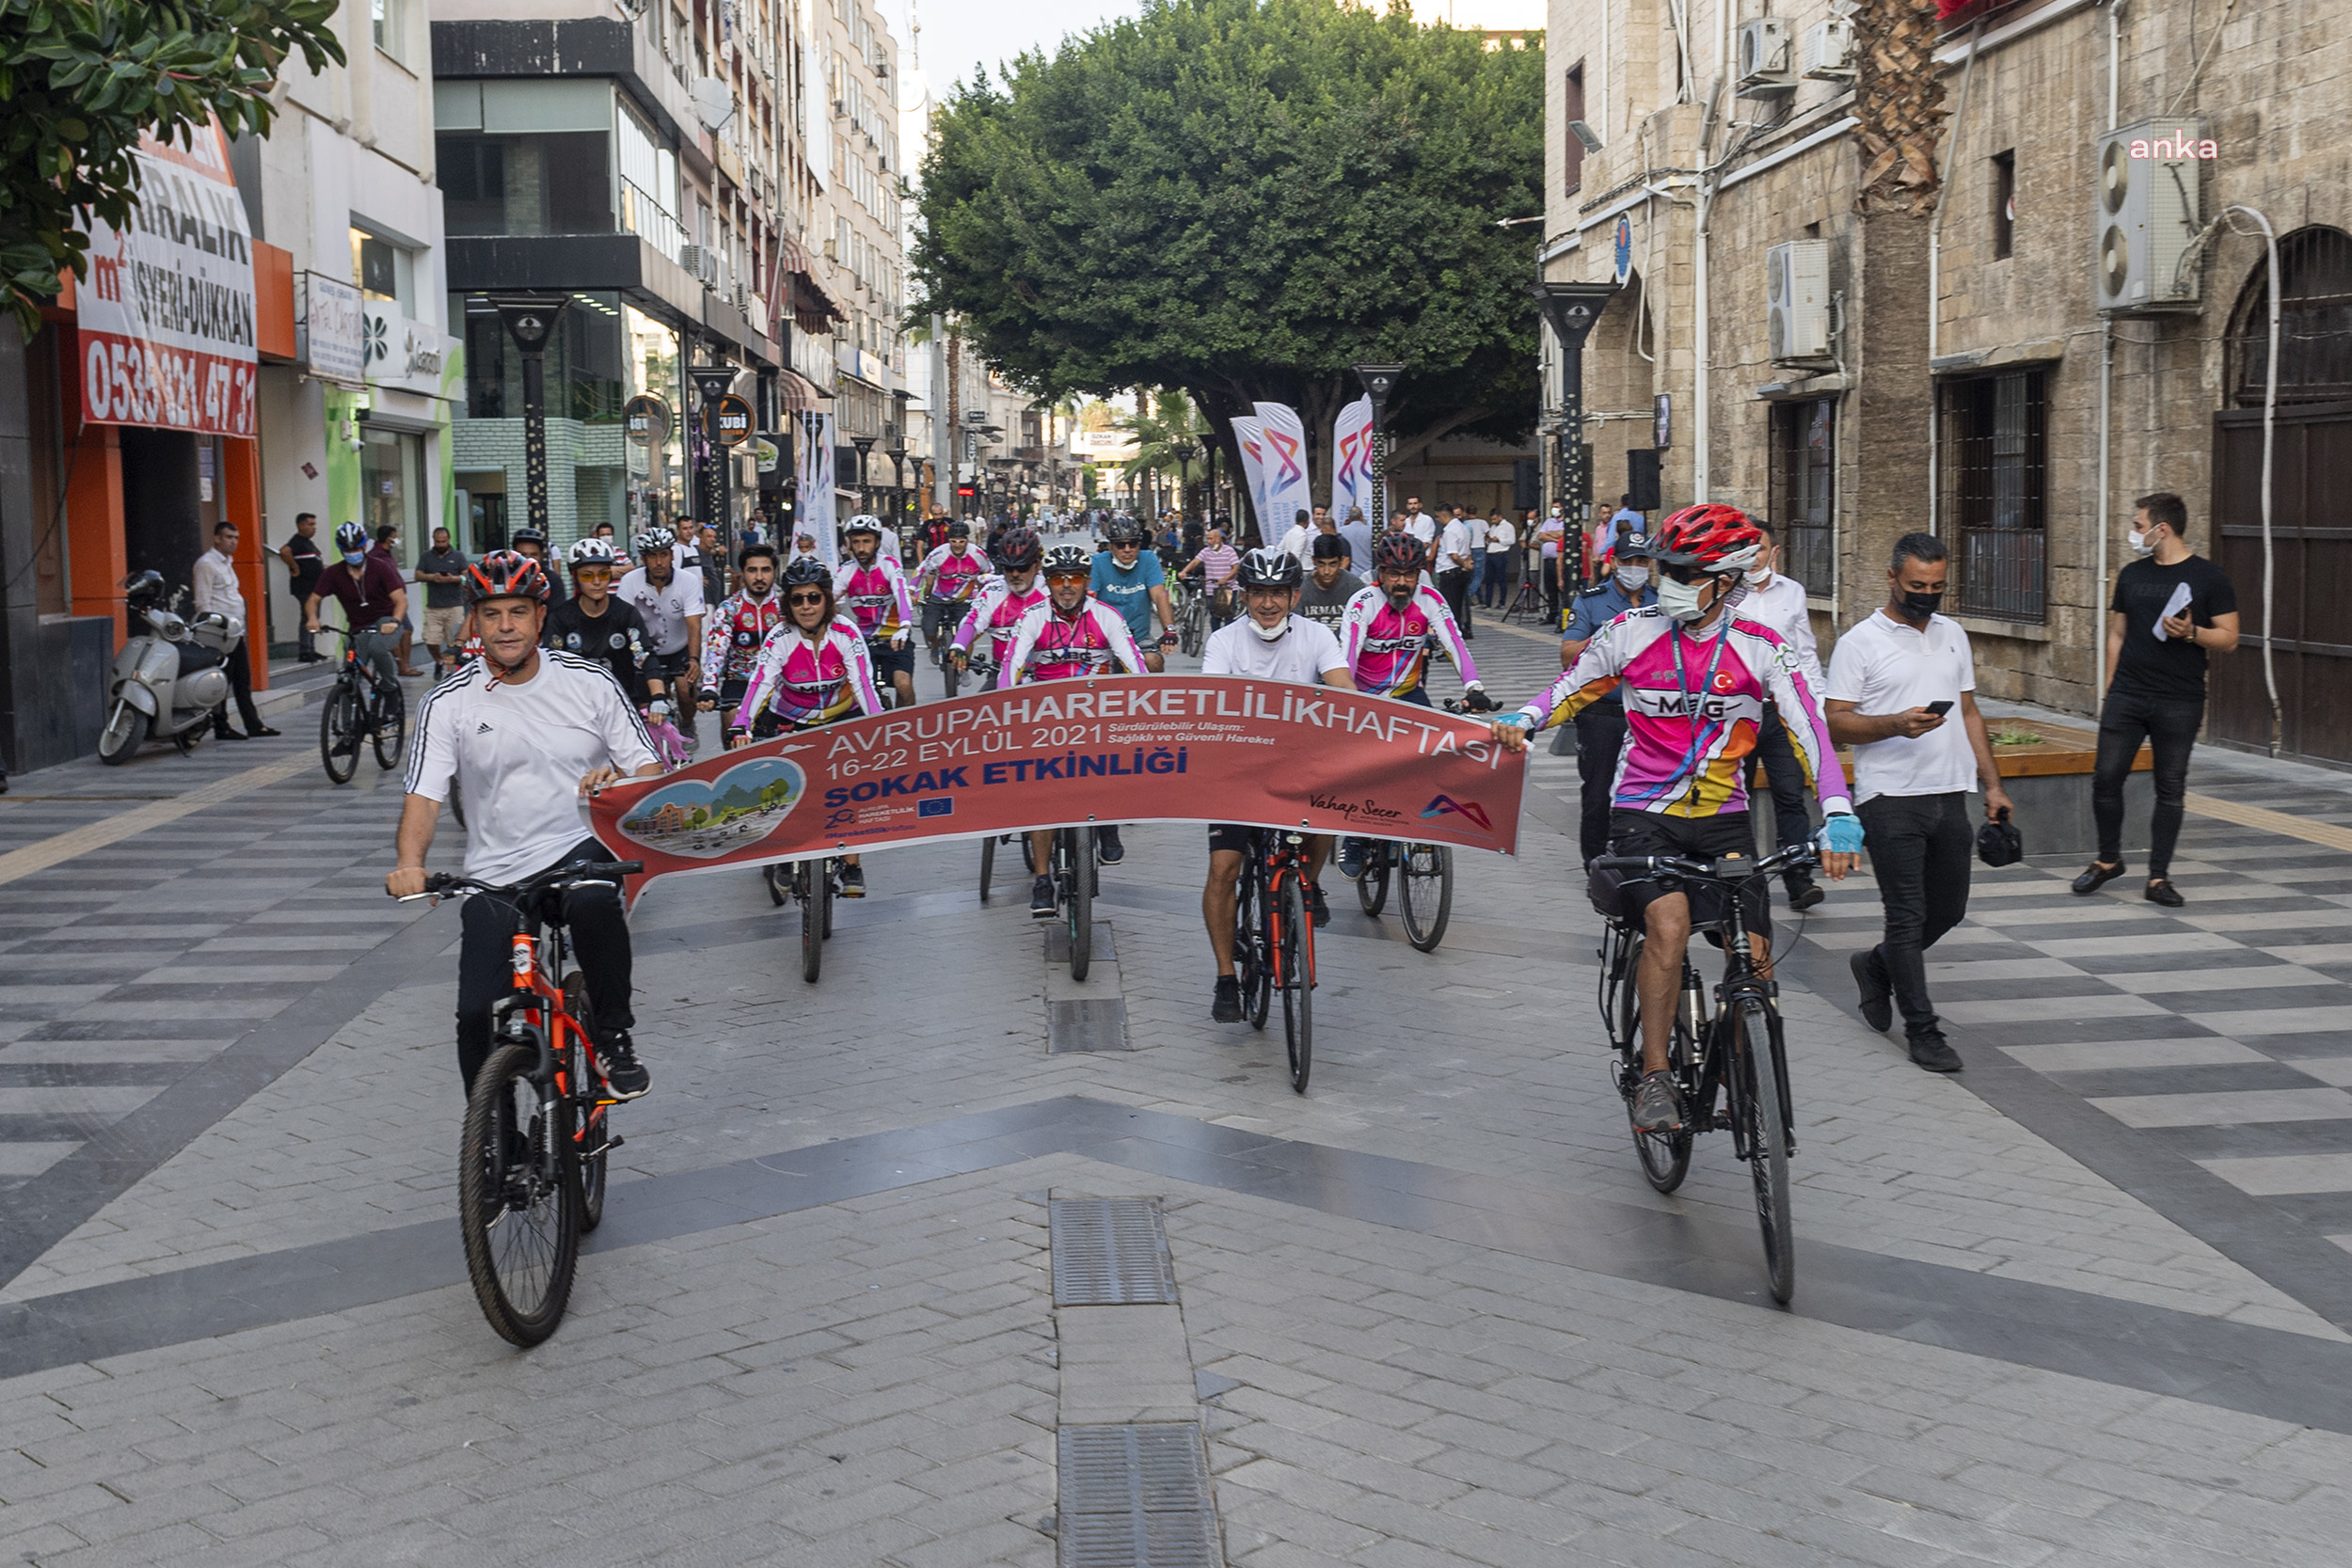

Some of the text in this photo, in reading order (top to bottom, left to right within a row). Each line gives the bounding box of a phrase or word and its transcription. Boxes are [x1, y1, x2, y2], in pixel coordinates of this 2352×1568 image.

[87, 340, 159, 422] 0535
[205, 361, 230, 431] 47
[236, 367, 256, 435] 31
[1629, 606, 1664, 618] MB
[1107, 734, 1154, 745] Sağlıklı
[1175, 732, 1223, 742] Güvenli
[1226, 734, 1276, 745] Hareket
[1108, 721, 1245, 733] Sürdürülebilir Ulaşım:
[826, 723, 1102, 781] 16-22 EYLÜL 2021
[825, 746, 1187, 809] SOKAK ETKİNLİĞİ
[1310, 793, 1359, 820] Vahap
